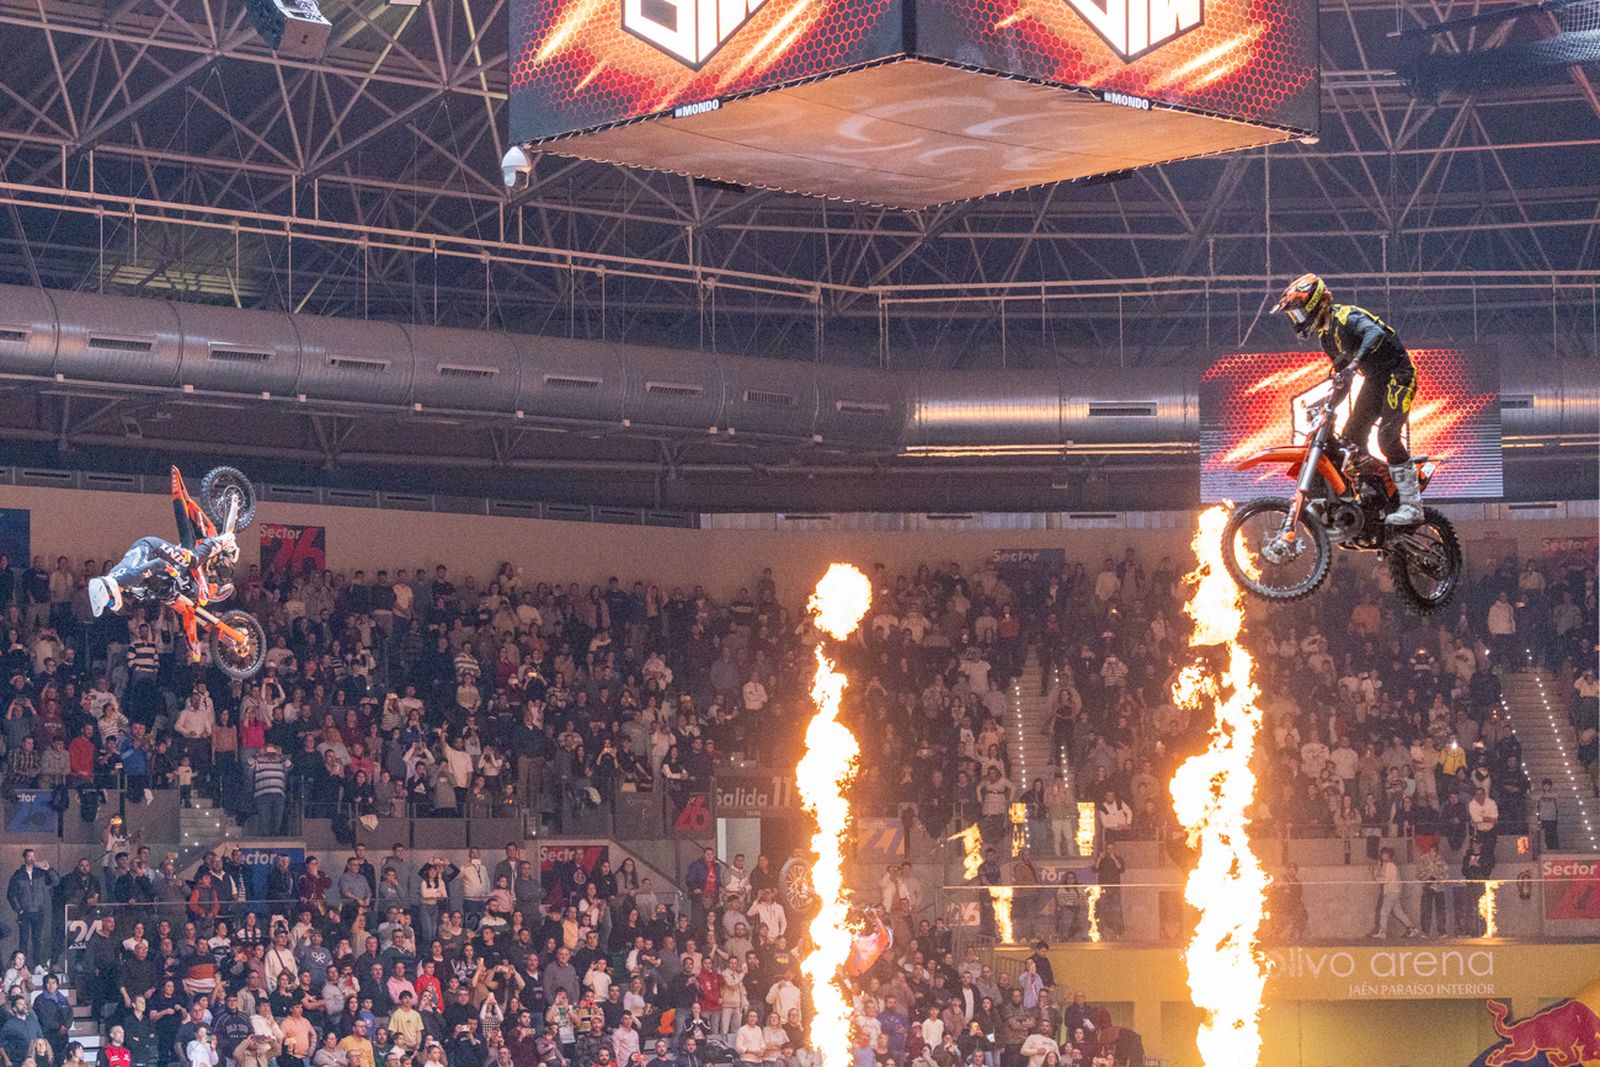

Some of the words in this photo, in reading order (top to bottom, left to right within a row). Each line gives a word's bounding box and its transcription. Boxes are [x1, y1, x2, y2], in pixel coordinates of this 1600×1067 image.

[682, 99, 720, 118] MONDO
[1112, 93, 1149, 110] MONDO
[260, 524, 302, 539] Sector
[1543, 861, 1598, 876] Sector
[1370, 950, 1494, 977] arena
[1350, 981, 1380, 997] JAÉN
[1381, 982, 1435, 996] PARAÍSO
[1437, 982, 1495, 996] INTERIOR
